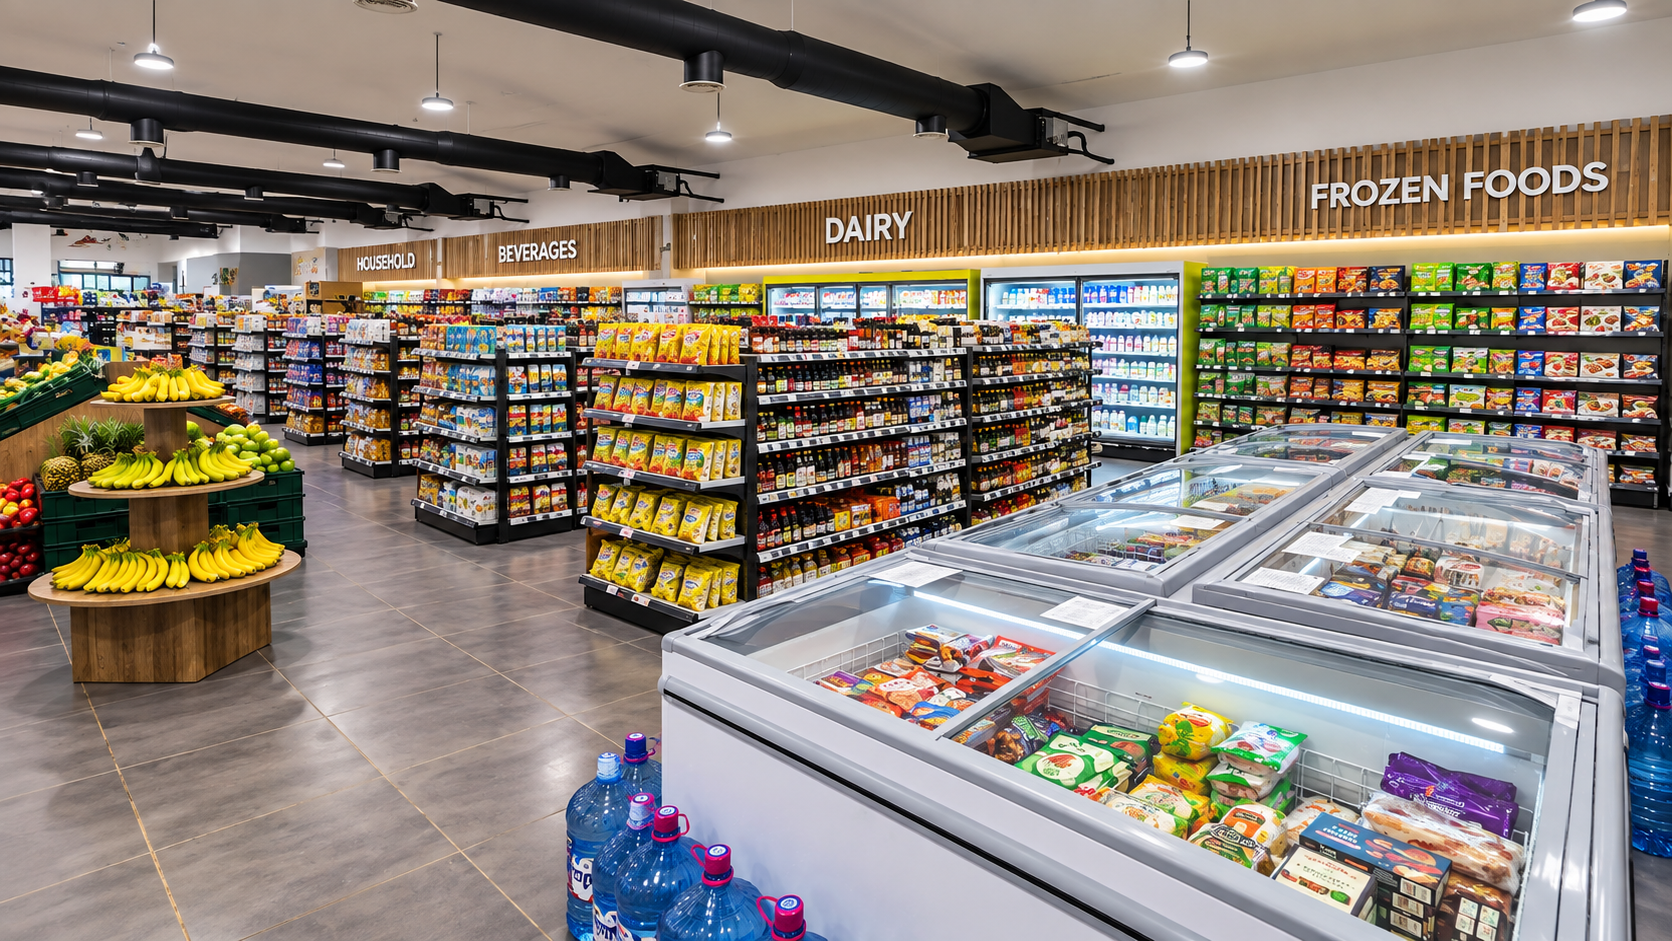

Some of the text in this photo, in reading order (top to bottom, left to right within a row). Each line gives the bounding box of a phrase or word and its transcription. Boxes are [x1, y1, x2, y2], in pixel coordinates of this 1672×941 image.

[1311, 161, 1609, 209] FROZEN FOODS
[826, 211, 913, 244] DAIRY
[357, 252, 416, 271] HOUSEHOLD
[499, 240, 577, 263] BEVERAGES
